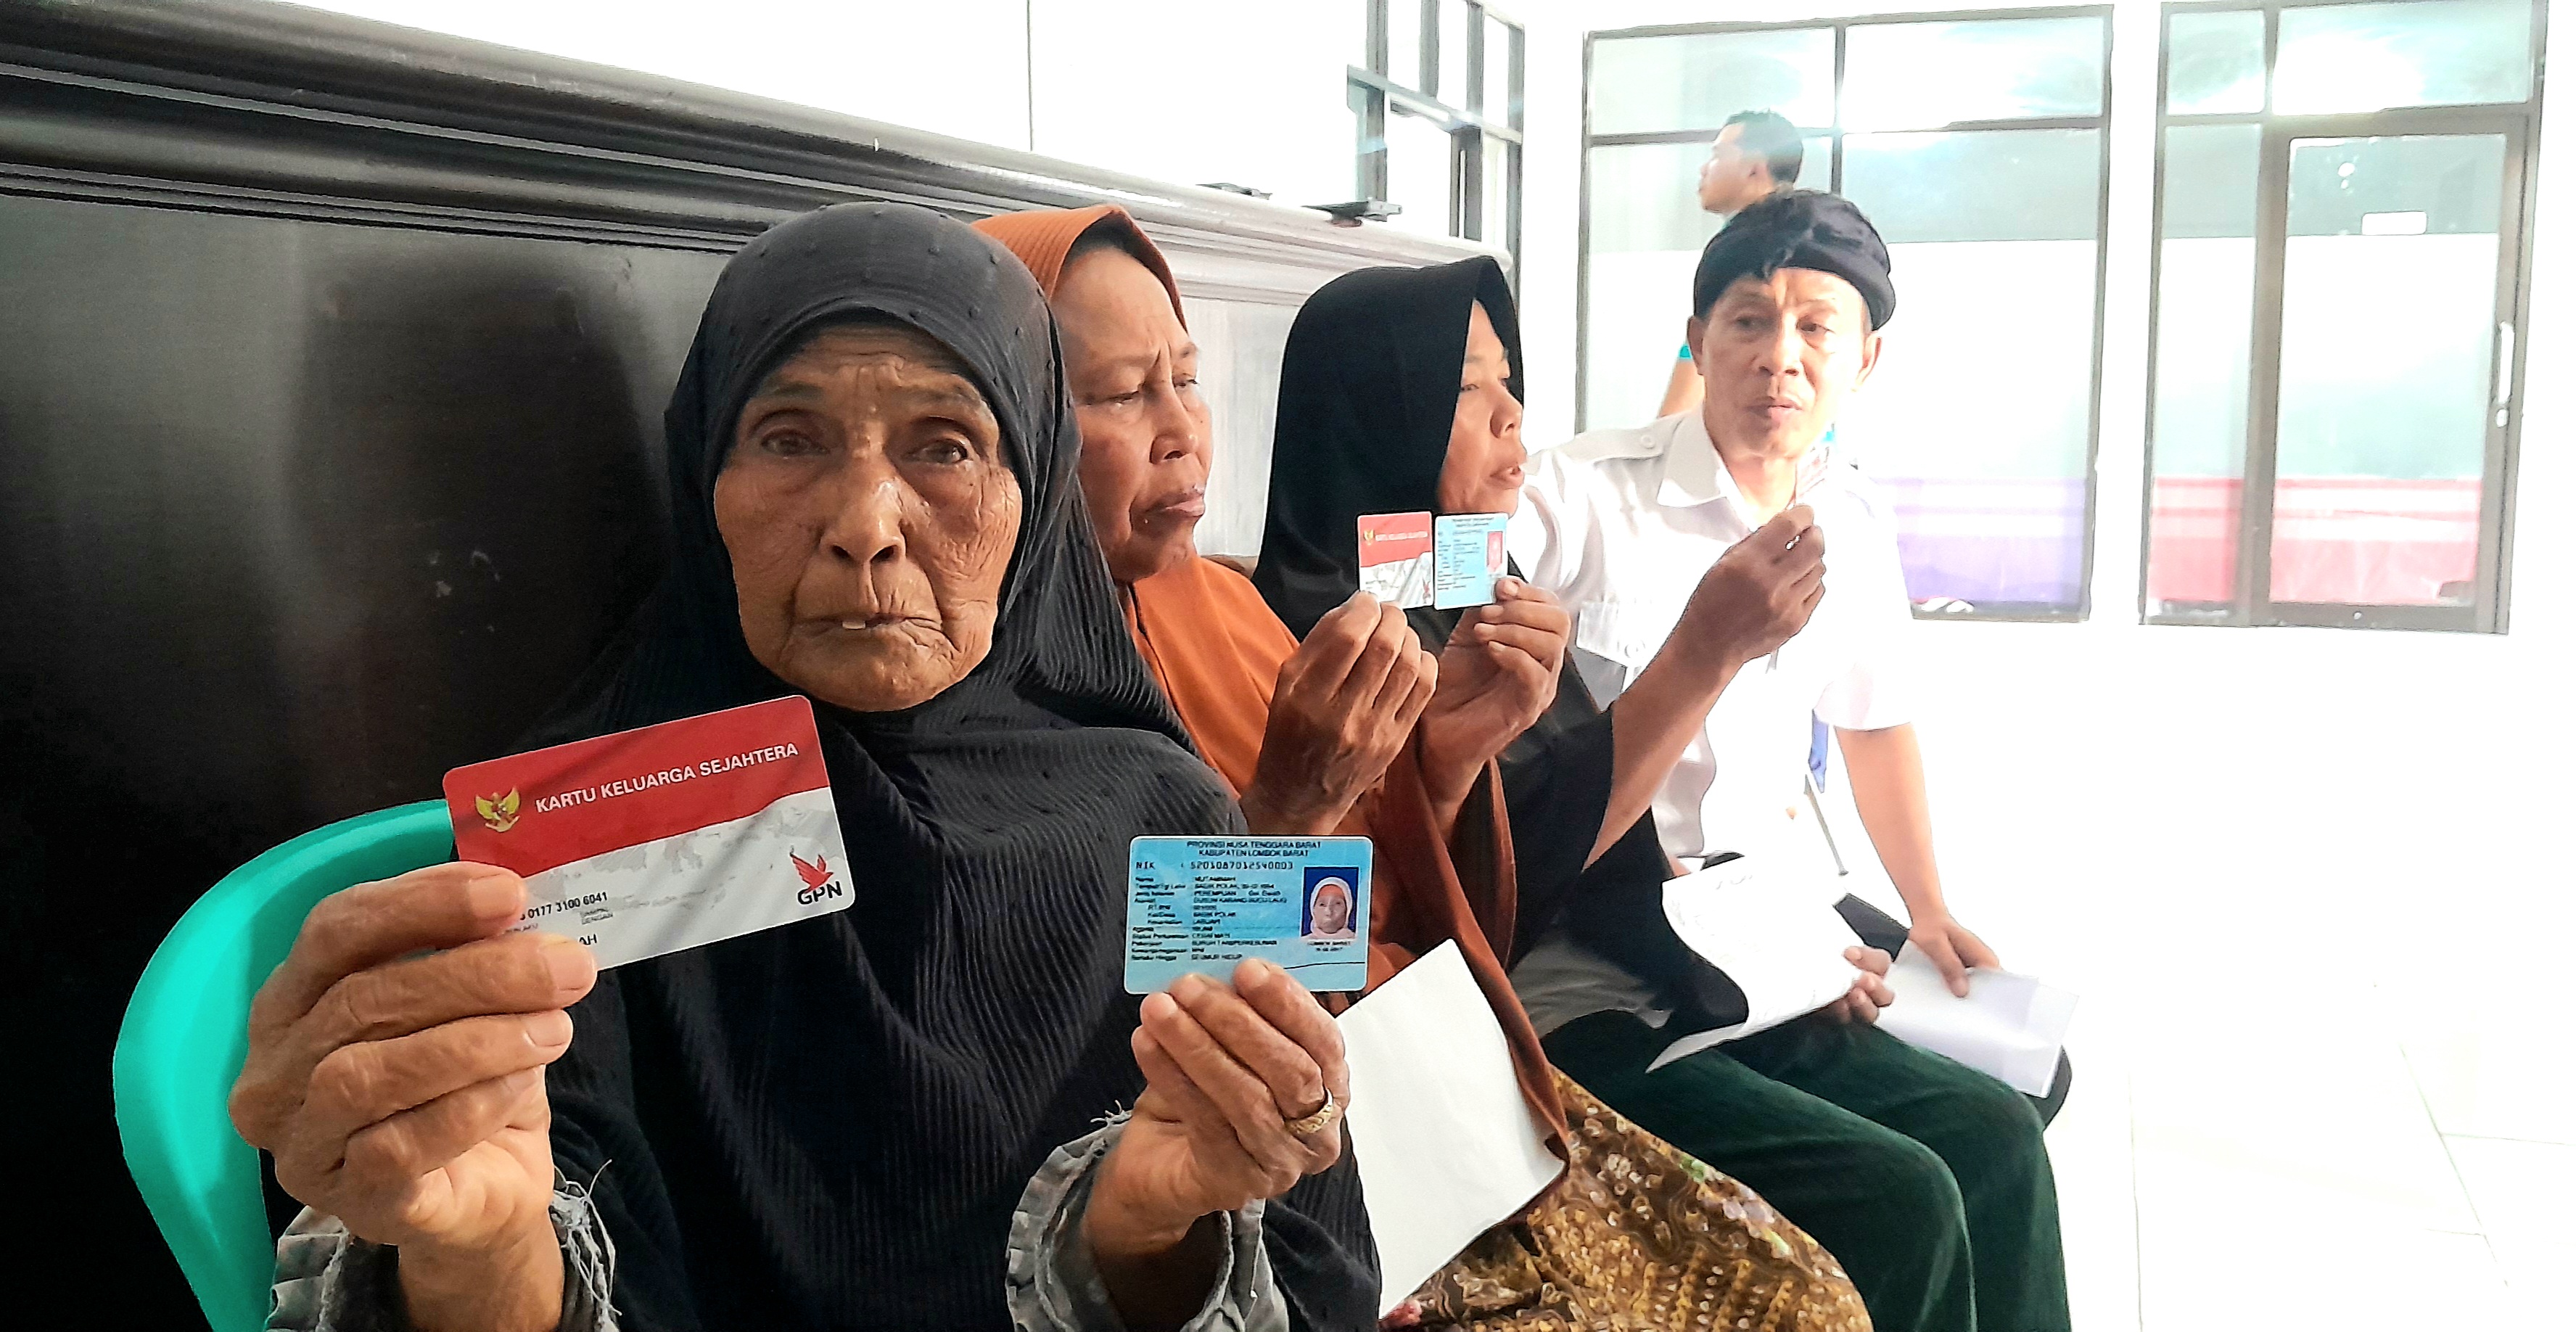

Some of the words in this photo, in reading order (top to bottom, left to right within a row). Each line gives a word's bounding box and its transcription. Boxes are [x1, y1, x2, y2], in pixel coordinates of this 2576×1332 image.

[535, 786, 596, 813] KARTU
[601, 767, 696, 799] KELUARGA
[699, 743, 798, 777] SEJAHTERA
[527, 904, 552, 918] 0177
[583, 892, 607, 905] 6041
[797, 881, 842, 905] GPN
